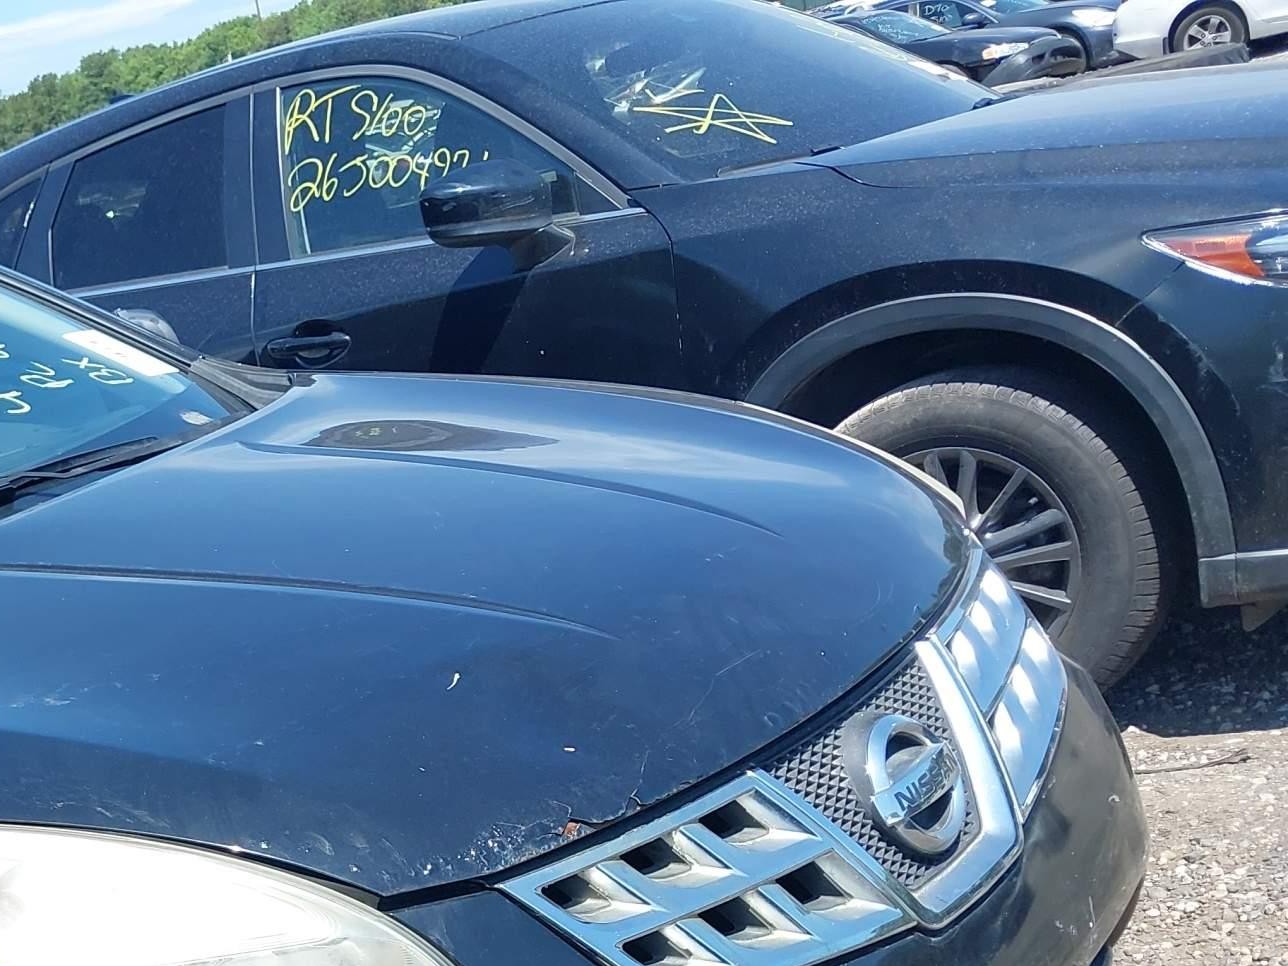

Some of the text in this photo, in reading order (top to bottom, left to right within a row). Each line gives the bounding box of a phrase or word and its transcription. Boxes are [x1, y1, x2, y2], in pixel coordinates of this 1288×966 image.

[285, 85, 426, 155] RT S100
[894, 751, 958, 812] NISSAN
